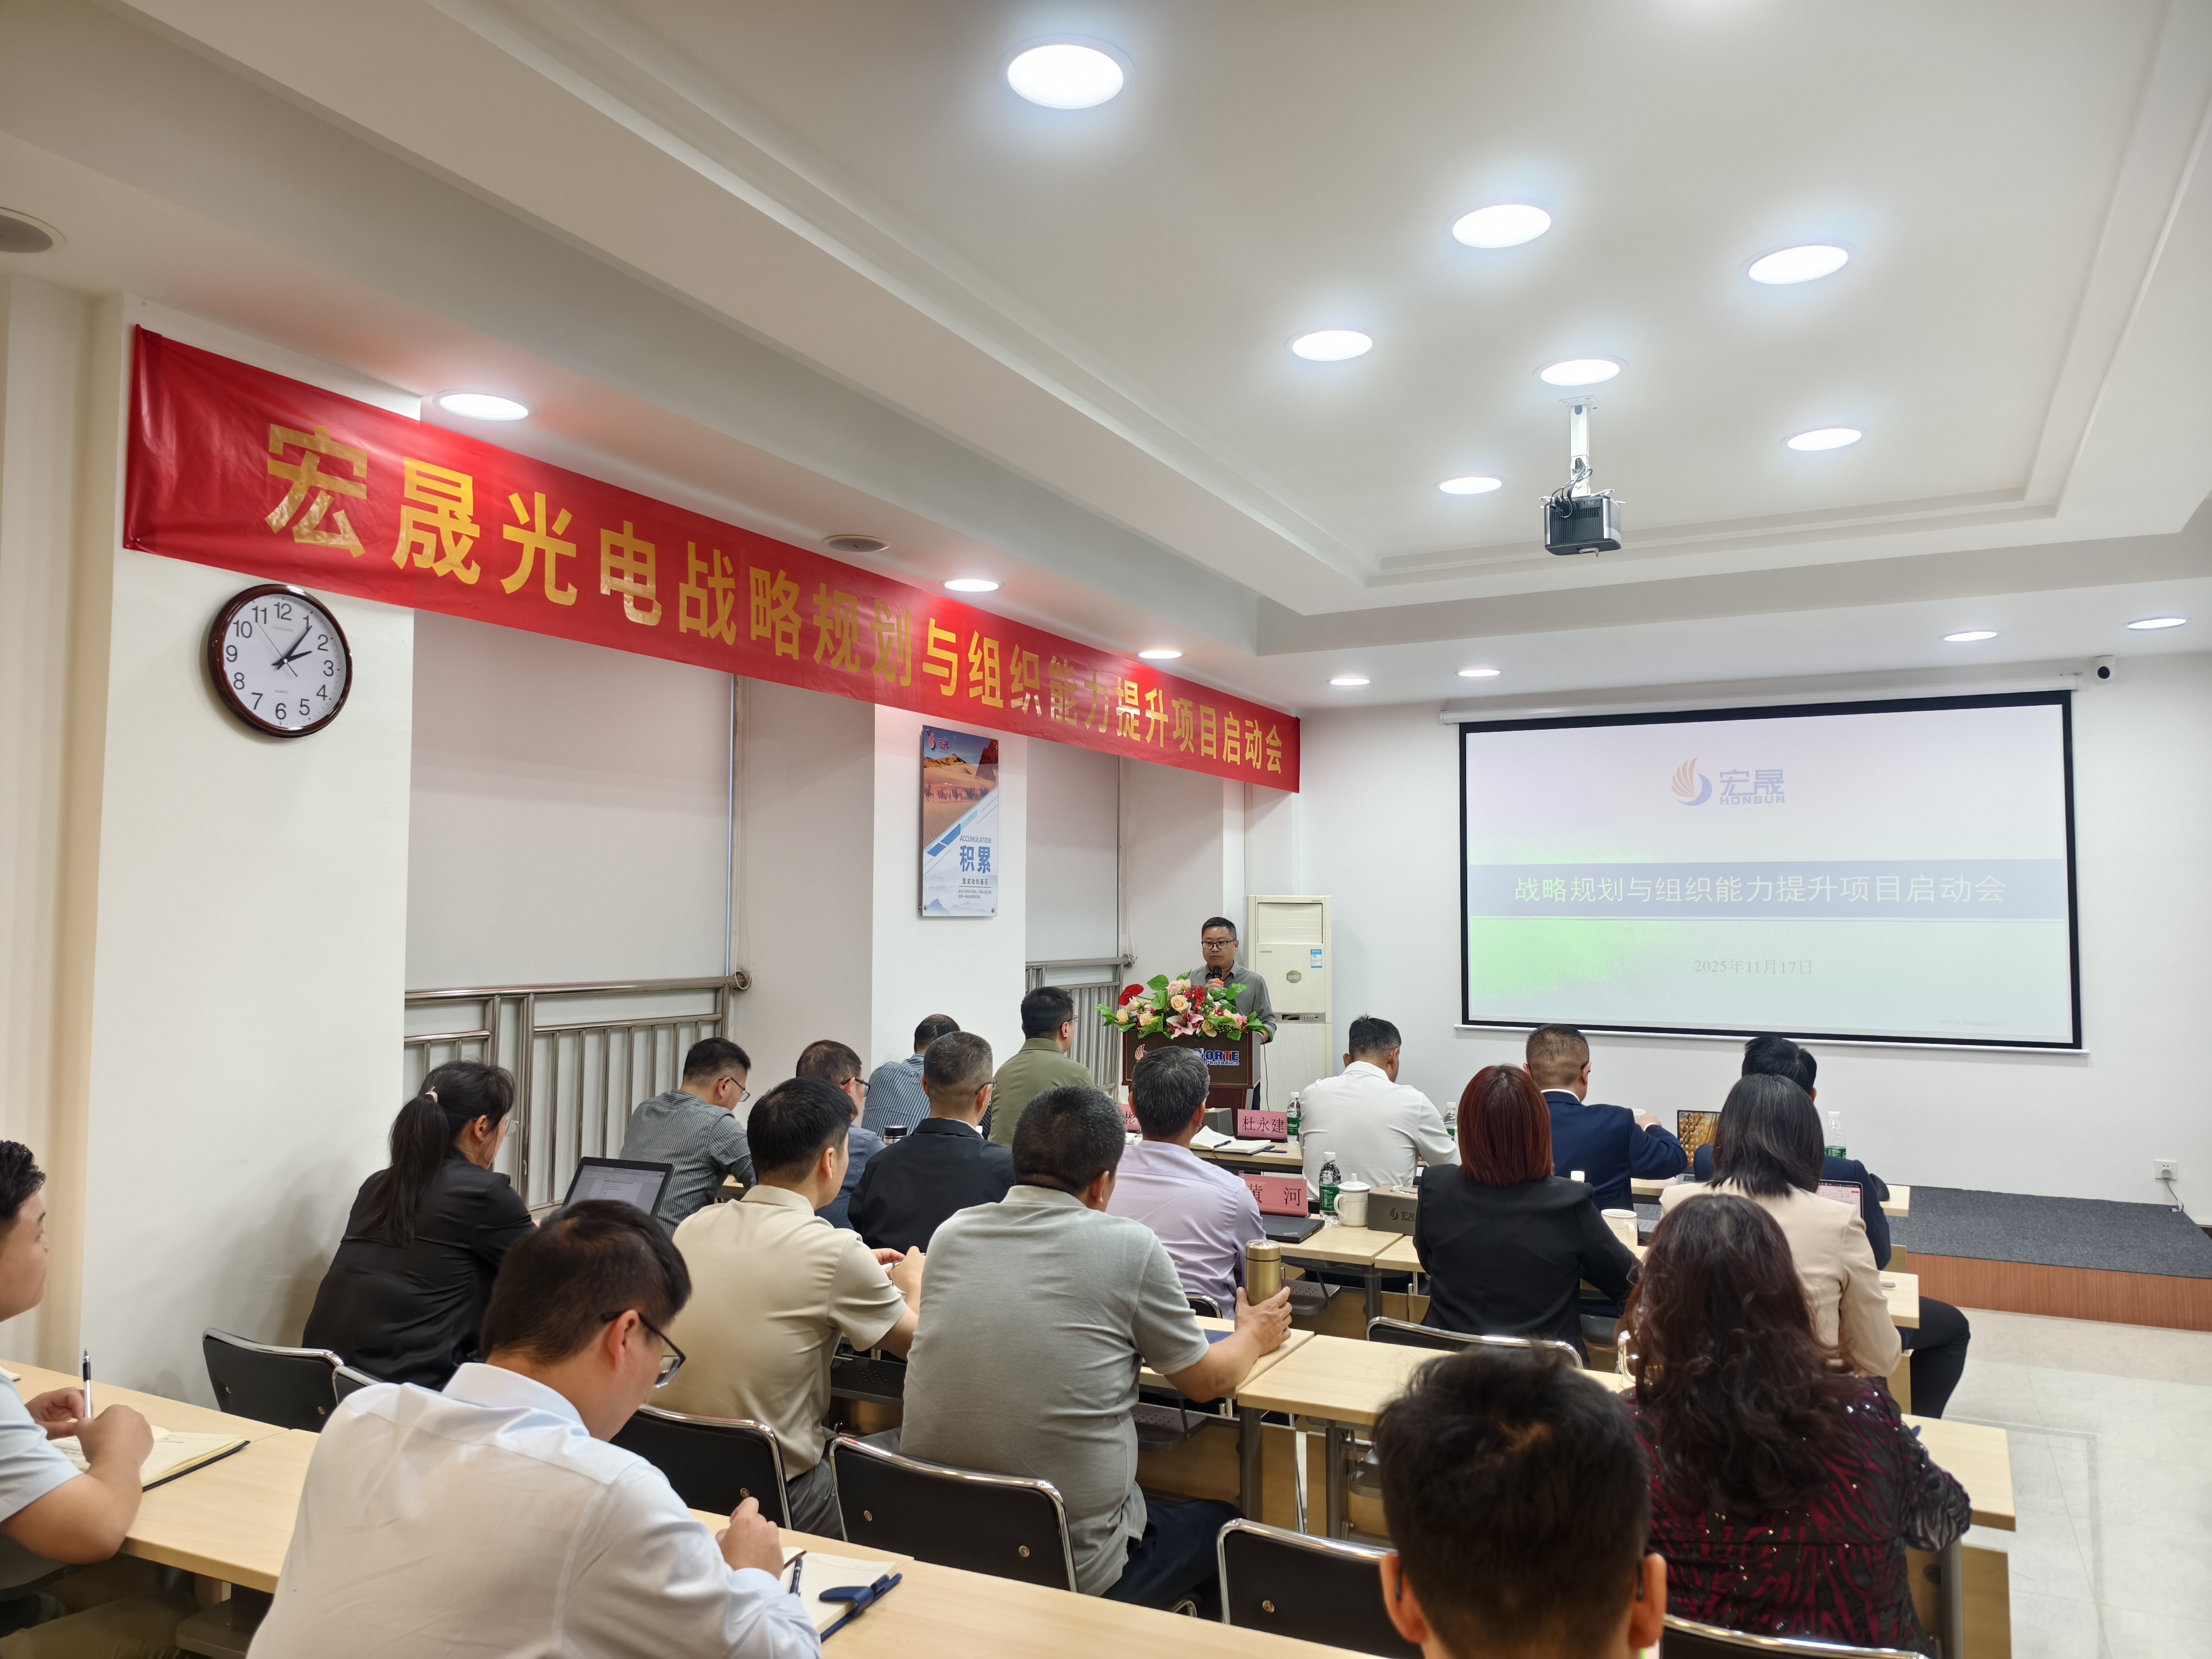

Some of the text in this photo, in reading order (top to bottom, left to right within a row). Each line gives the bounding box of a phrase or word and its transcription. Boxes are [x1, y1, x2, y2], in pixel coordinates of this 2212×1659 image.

[264, 423, 1282, 774] 宏晟光电战略规划与组织能力提升项目启动会
[252, 605, 267, 624] 11
[274, 602, 292, 621] 12
[233, 619, 252, 638] 10
[303, 615, 310, 630] 1
[317, 634, 328, 651] 2
[226, 645, 238, 662] 9
[323, 660, 334, 676] 3
[233, 672, 245, 690] 8
[252, 692, 263, 710] 7
[316, 684, 328, 701] 4
[275, 703, 286, 719] 6
[299, 699, 310, 716] 5
[1719, 769, 1784, 796] 宏晟
[1720, 795, 1785, 805] HONSUN
[960, 835, 992, 844] ACCUMULATION
[960, 845, 990, 874] 积累
[1515, 874, 2007, 902] 战略规划与组织能力提升项目启动会
[1694, 959, 1812, 975] 2025年11月17日
[1242, 1116, 1285, 1133] 杜永建
